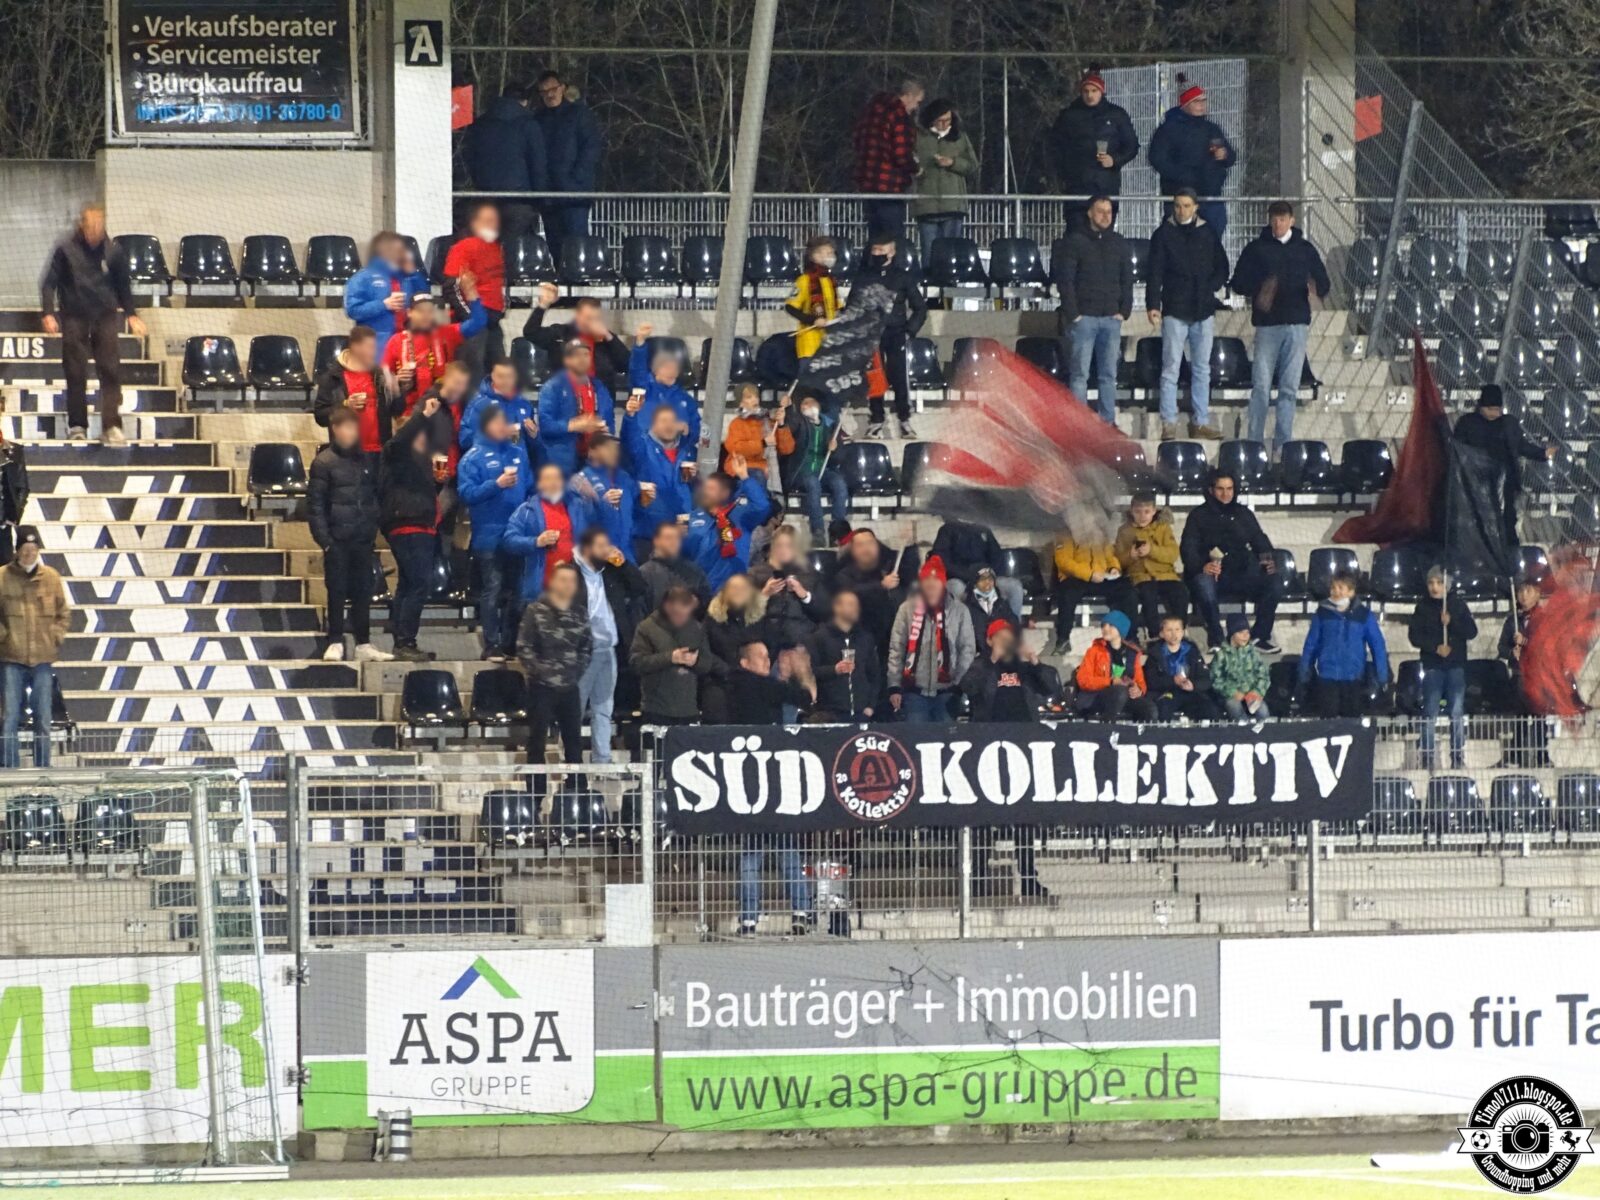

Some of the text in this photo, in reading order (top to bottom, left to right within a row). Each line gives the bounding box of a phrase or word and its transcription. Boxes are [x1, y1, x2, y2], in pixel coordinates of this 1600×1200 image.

[144, 14, 337, 38] Verkaufsberater
[409, 25, 438, 62] A
[146, 43, 321, 66] Servicemeister
[855, 736, 890, 753] Süd
[671, 735, 1353, 815] SÜD KOLLEKTIV
[835, 773, 848, 784] 20
[840, 784, 909, 818] Kollektiv
[686, 970, 1198, 1039] Bauträger + Immobilien
[389, 1011, 572, 1065] ASPA
[1309, 998, 1454, 1052] Turbo
[1469, 995, 1542, 1049] für
[431, 1075, 532, 1097] GRUPPE
[686, 1052, 1199, 1121] www.aspa-gruppe.de
